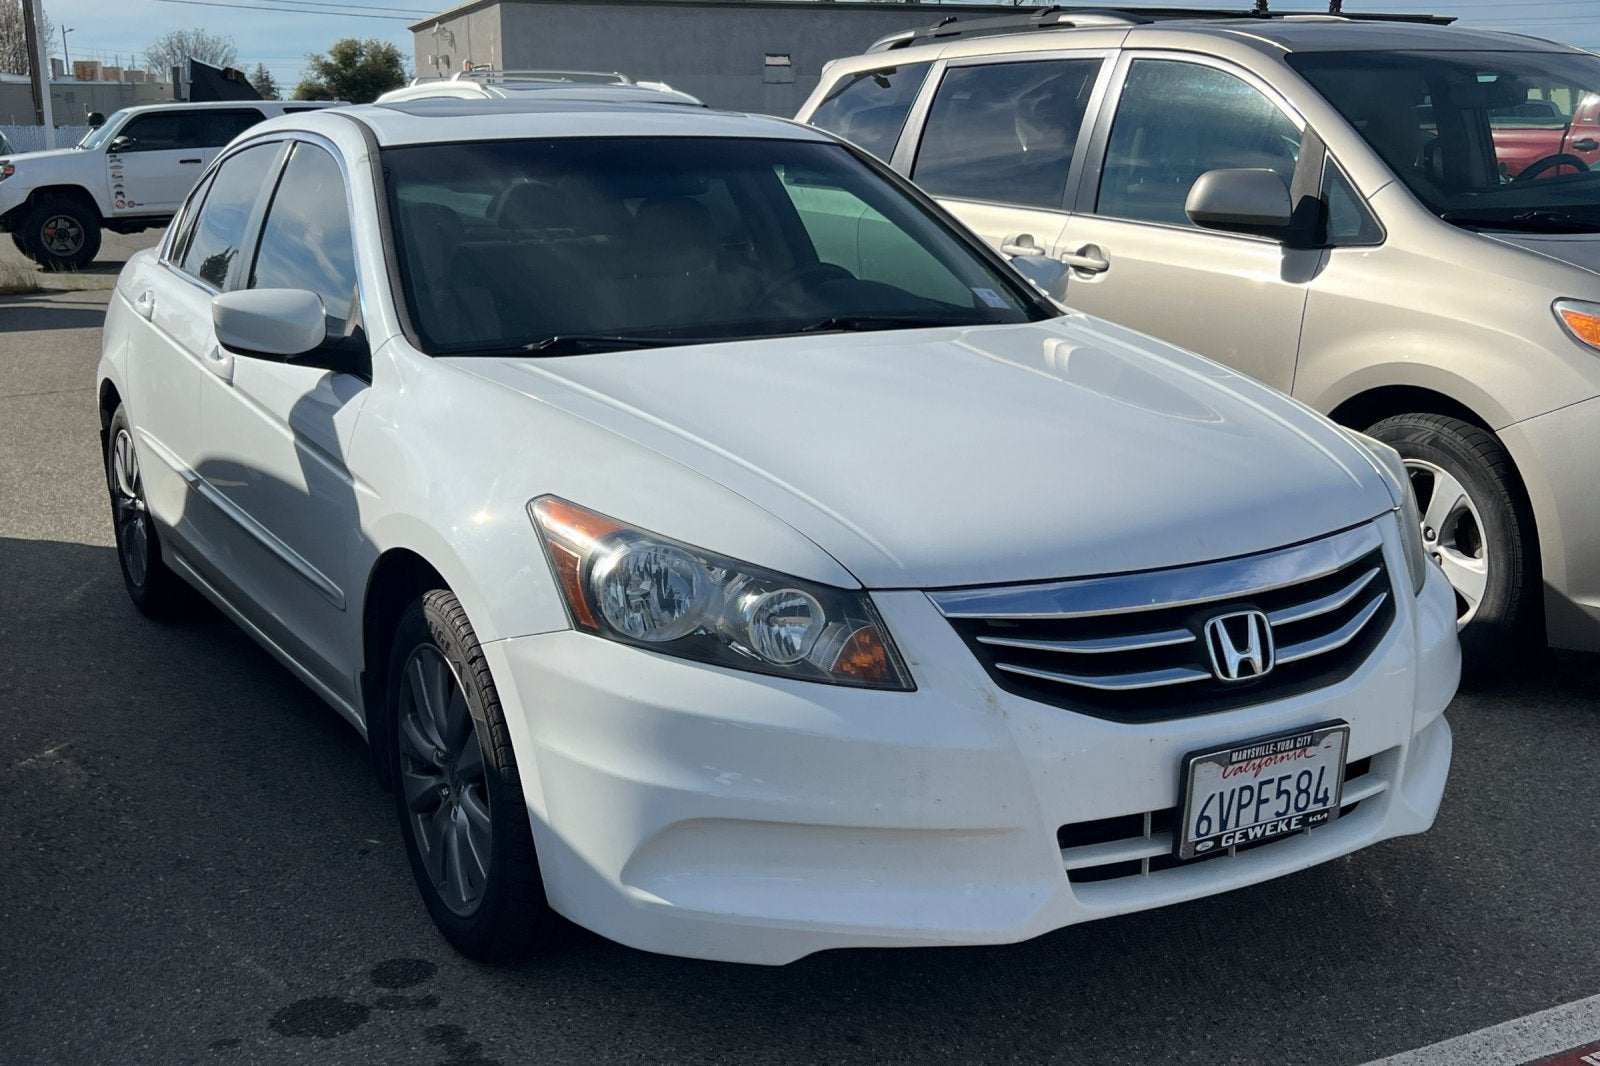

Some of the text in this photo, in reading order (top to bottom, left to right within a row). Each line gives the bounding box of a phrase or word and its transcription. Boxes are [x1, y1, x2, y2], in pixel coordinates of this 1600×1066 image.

[1296, 735, 1312, 748] CITY
[1222, 748, 1317, 779] California
[1195, 766, 1330, 839] 6VPF584
[1221, 815, 1303, 847] GEWEKE
